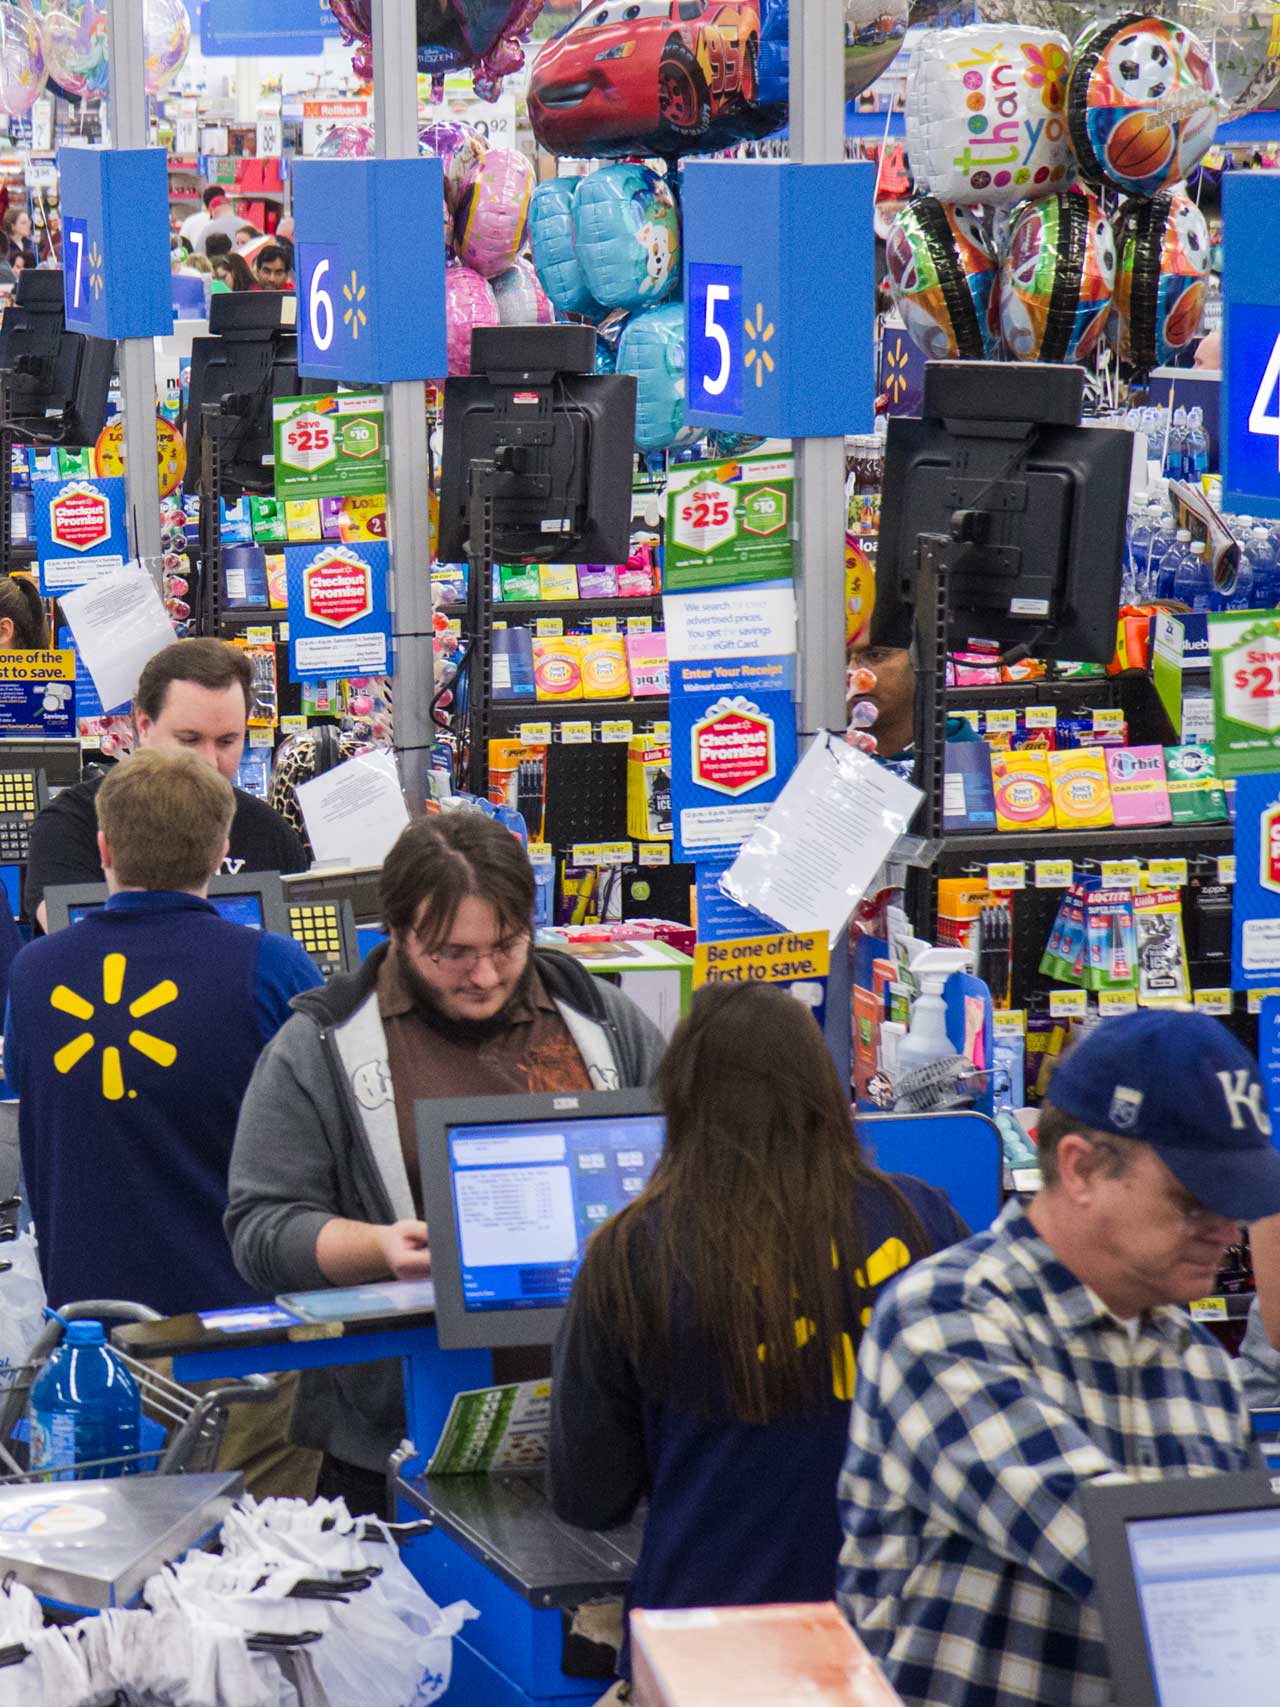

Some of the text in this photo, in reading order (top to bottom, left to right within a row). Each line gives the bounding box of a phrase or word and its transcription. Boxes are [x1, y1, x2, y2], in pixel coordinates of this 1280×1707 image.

[320, 104, 362, 116] Rollback
[946, 43, 1019, 177] thank
[70, 232, 83, 308] 7
[309, 259, 333, 351] 6
[703, 284, 730, 395] 5
[1248, 333, 1280, 472] 4
[295, 420, 320, 430] Save
[287, 430, 329, 451] $25
[692, 491, 720, 502] Save
[56, 505, 104, 516] Checkout
[752, 501, 776, 514] $10
[682, 501, 729, 528] $25
[56, 516, 104, 527] Promise
[310, 574, 365, 587] Checkout
[310, 586, 365, 599] Promise
[686, 615, 733, 625] advertised
[738, 626, 771, 637] savings
[26, 652, 39, 664] of
[40, 652, 63, 664] the
[12, 667, 27, 678] to
[30, 668, 67, 678] save.
[682, 664, 783, 679] Enter Your Receipt
[1234, 666, 1280, 699] $2
[713, 722, 742, 731] Walmart
[699, 732, 766, 747] Checkout
[700, 746, 766, 762] Promise
[1167, 756, 1215, 769] eclipse
[1201, 886, 1227, 895] zippo
[707, 937, 815, 963] Be one of the
[706, 960, 817, 982] first to save.
